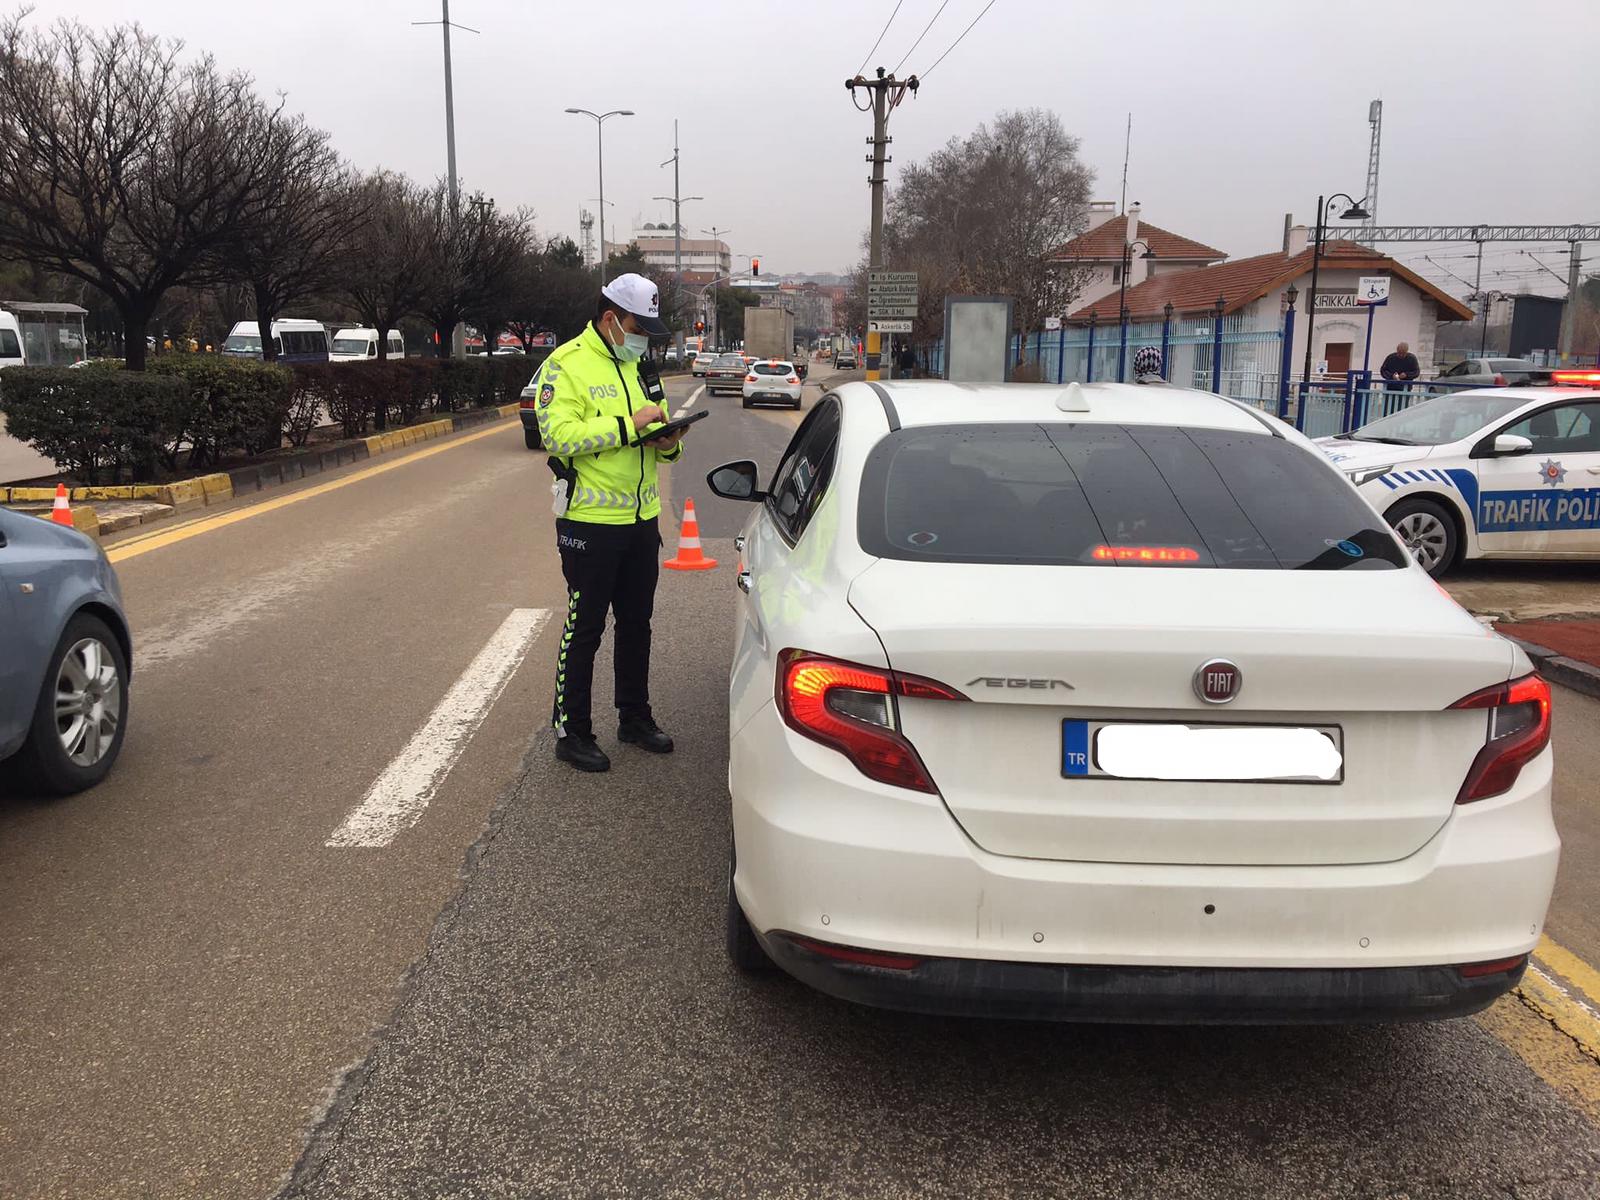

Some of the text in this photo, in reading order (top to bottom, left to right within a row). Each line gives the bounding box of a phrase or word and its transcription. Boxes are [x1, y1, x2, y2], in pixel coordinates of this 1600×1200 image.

[1313, 295, 1359, 307] KIRIKKAL
[1483, 491, 1600, 524] TRAFİK POLİ
[1207, 671, 1233, 693] FIAT
[1068, 752, 1086, 766] TR
